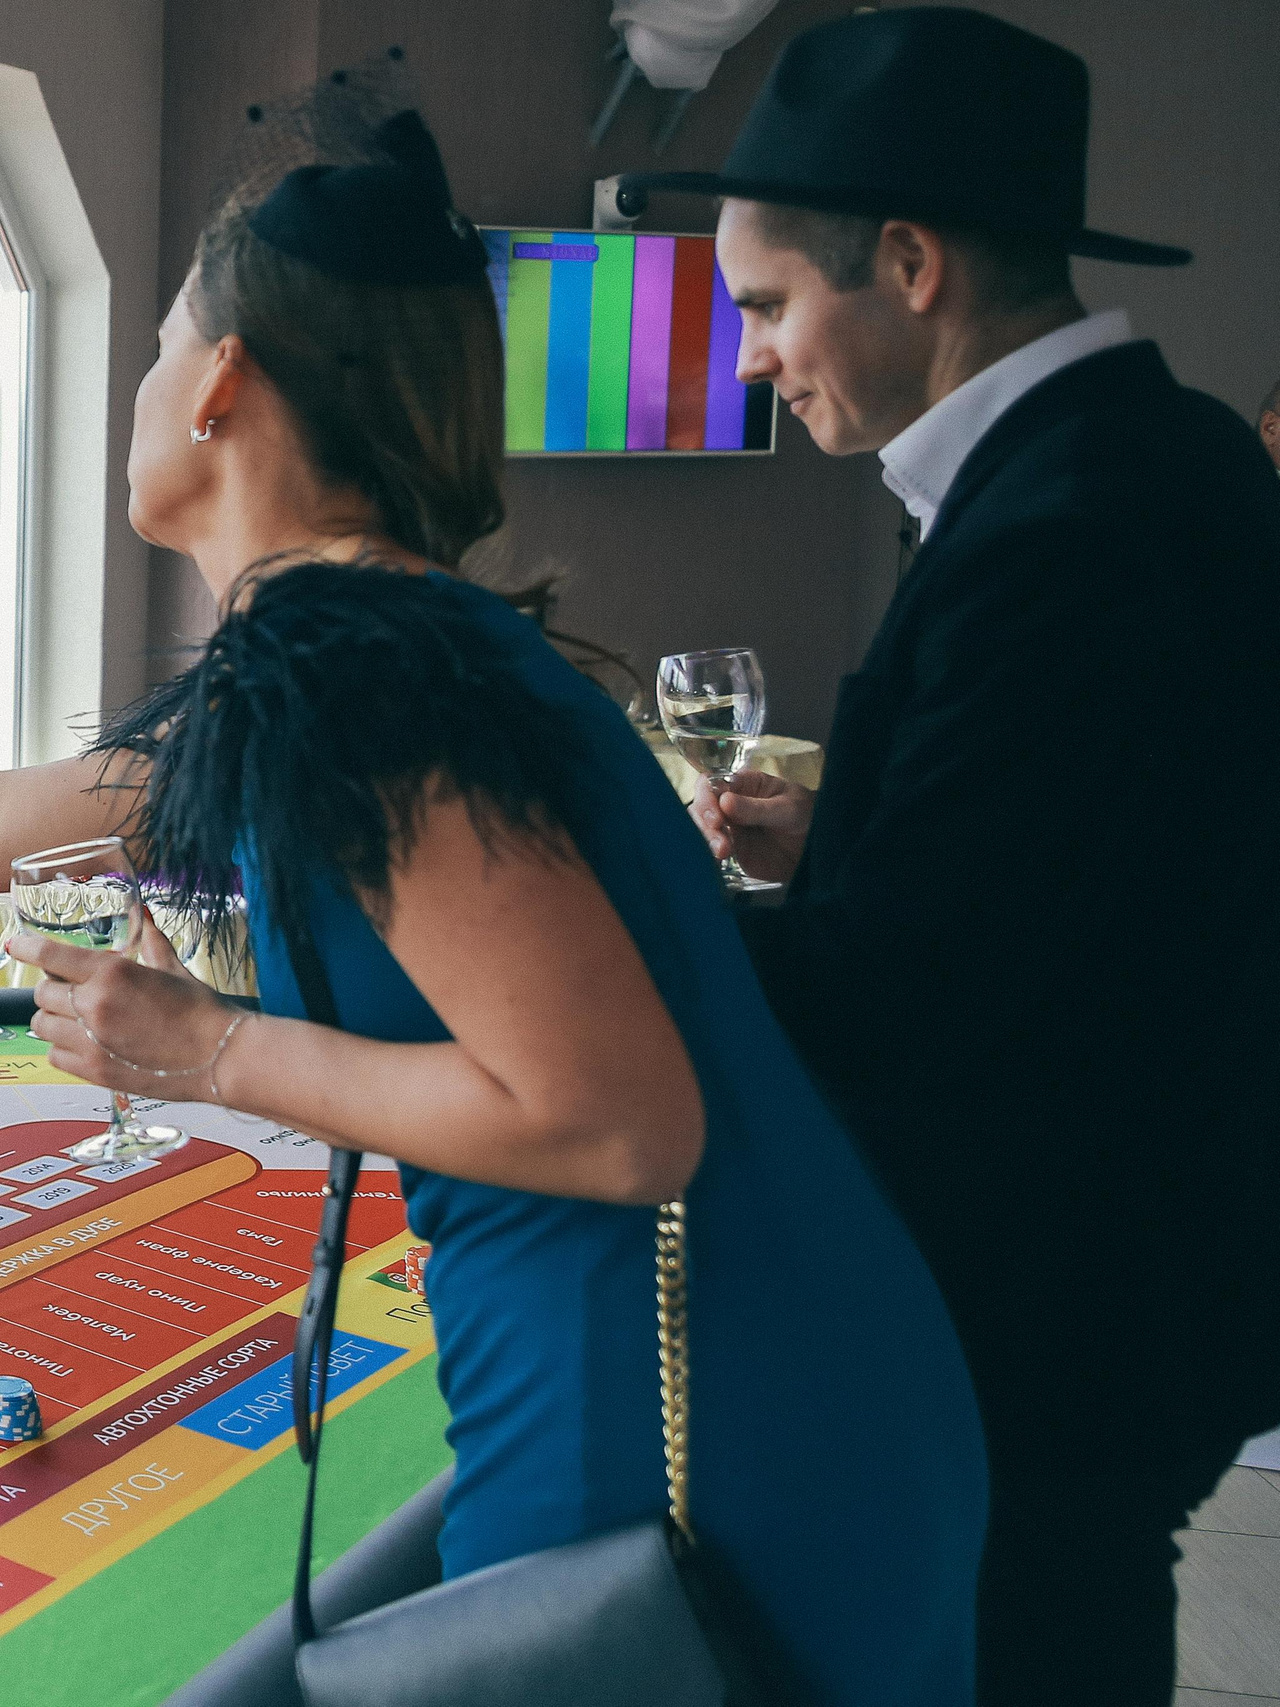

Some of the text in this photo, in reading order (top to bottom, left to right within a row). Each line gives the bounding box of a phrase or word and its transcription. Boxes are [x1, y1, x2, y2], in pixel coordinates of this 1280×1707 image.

[21, 1162, 56, 1177] 2014
[38, 1185, 71, 1201] 2019
[52, 1236, 76, 1249] В
[68, 1216, 124, 1245] ДУБЕ
[136, 1238, 283, 1290] Каберне фран
[95, 1272, 207, 1314] Пино нуар
[42, 1303, 136, 1342] Мальбек
[93, 1337, 278, 1447] АВТОХТОННЫЕ СОРТА
[61, 1462, 184, 1536] ДРУГОЕ
